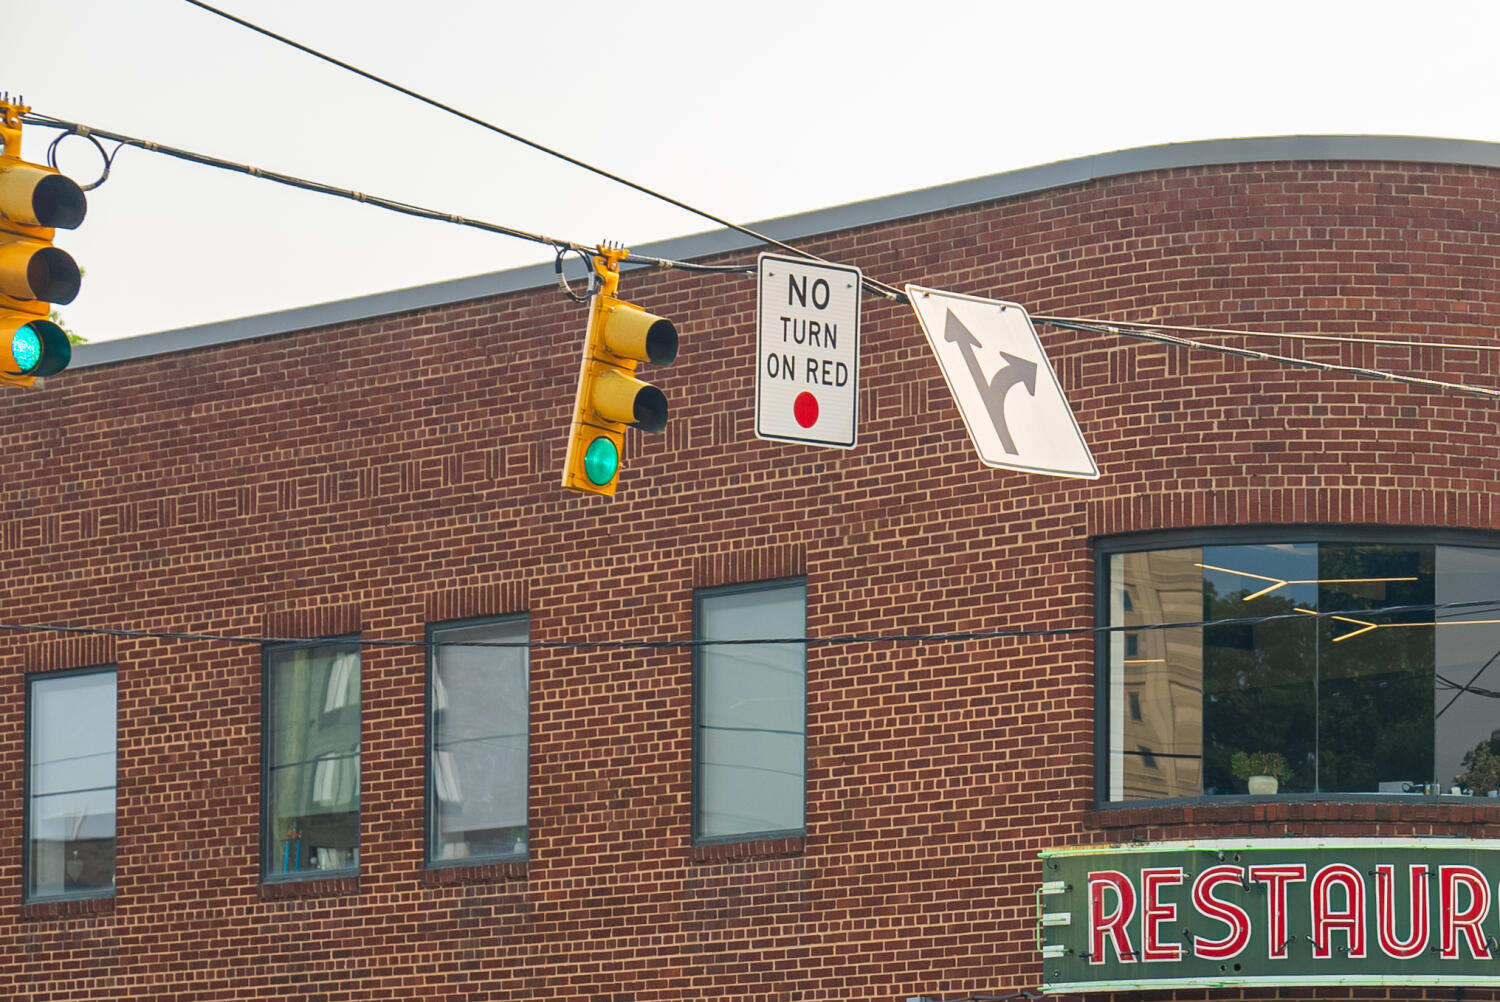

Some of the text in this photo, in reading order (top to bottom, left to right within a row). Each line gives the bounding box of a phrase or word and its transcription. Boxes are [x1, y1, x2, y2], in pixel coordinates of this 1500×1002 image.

[788, 273, 831, 311] NO
[780, 316, 838, 350] TURN
[767, 352, 849, 388] ON RED
